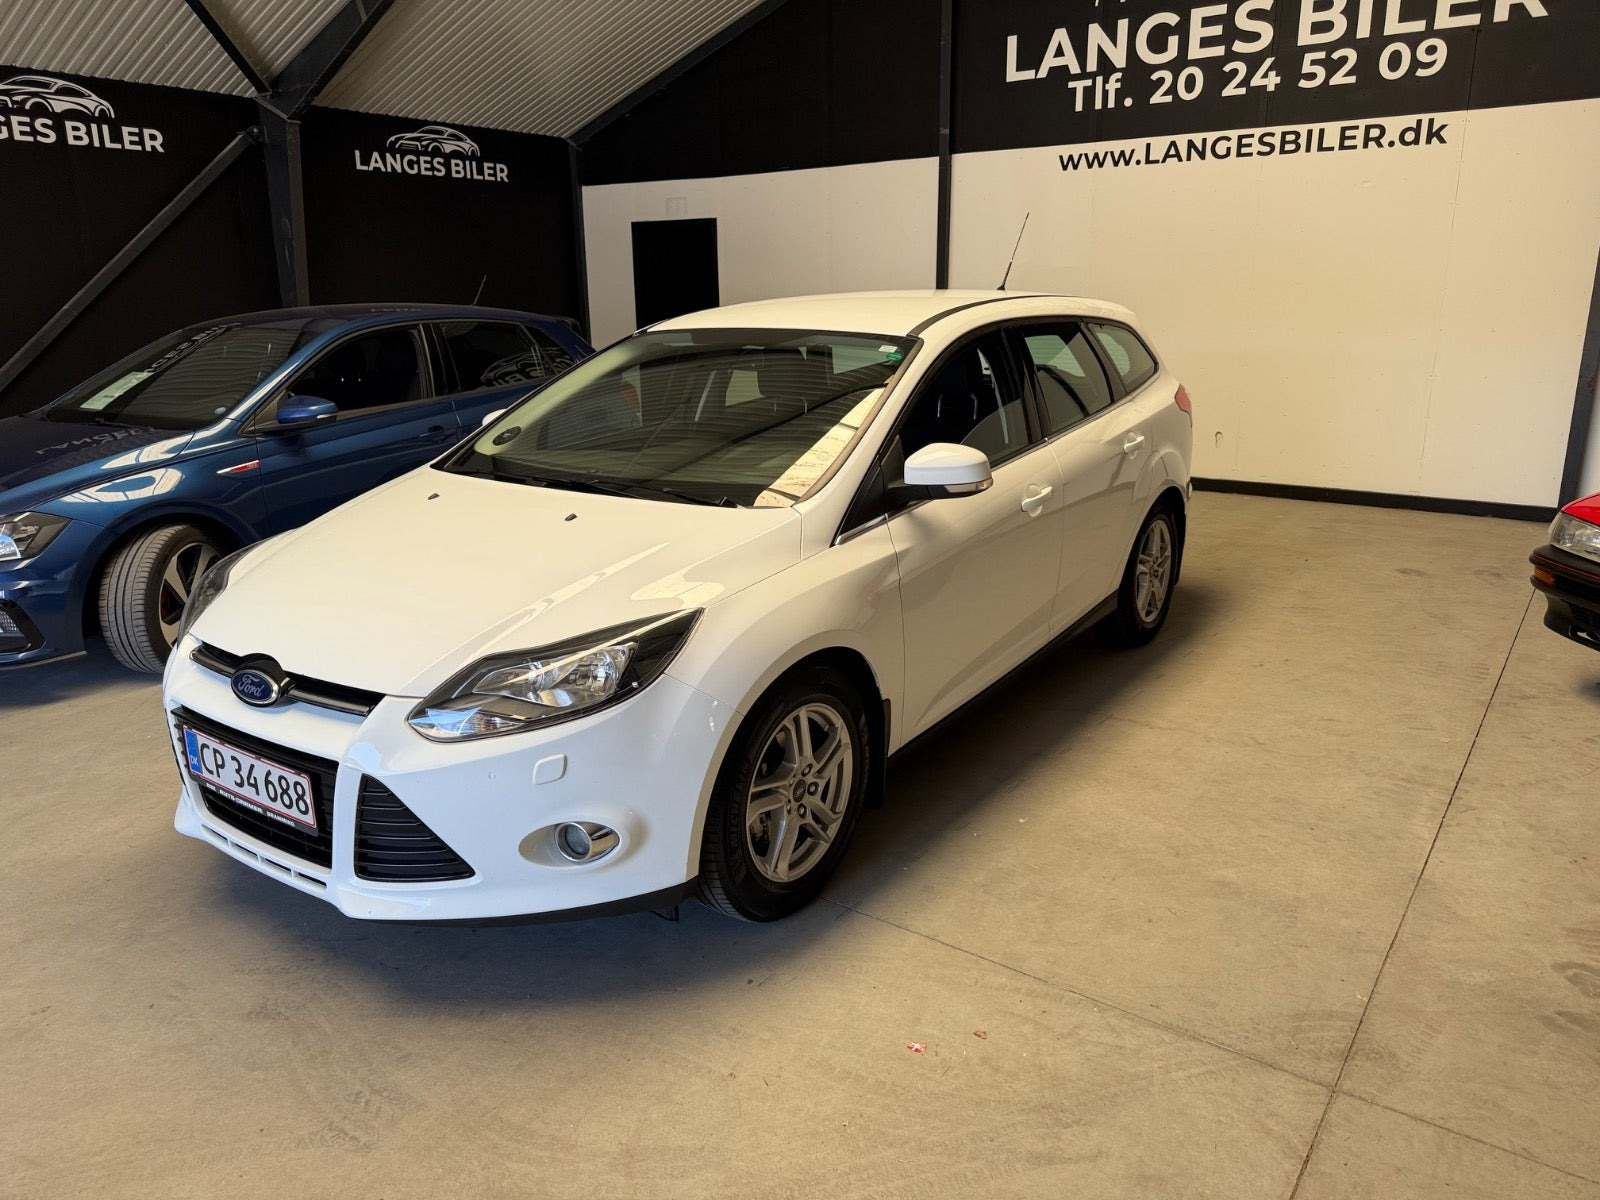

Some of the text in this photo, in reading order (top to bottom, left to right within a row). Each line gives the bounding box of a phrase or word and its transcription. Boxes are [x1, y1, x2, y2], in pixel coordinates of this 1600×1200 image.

[1005, 0, 1275, 83] LANGES
[1067, 37, 1448, 112] Tlf. 20 24 52 09
[64, 120, 165, 153] BILER
[1058, 117, 1448, 171] www.LANGESBILER.dk
[354, 149, 509, 182] LANGES BILER
[237, 674, 264, 698] Ford
[200, 742, 310, 816] CP 34 688
